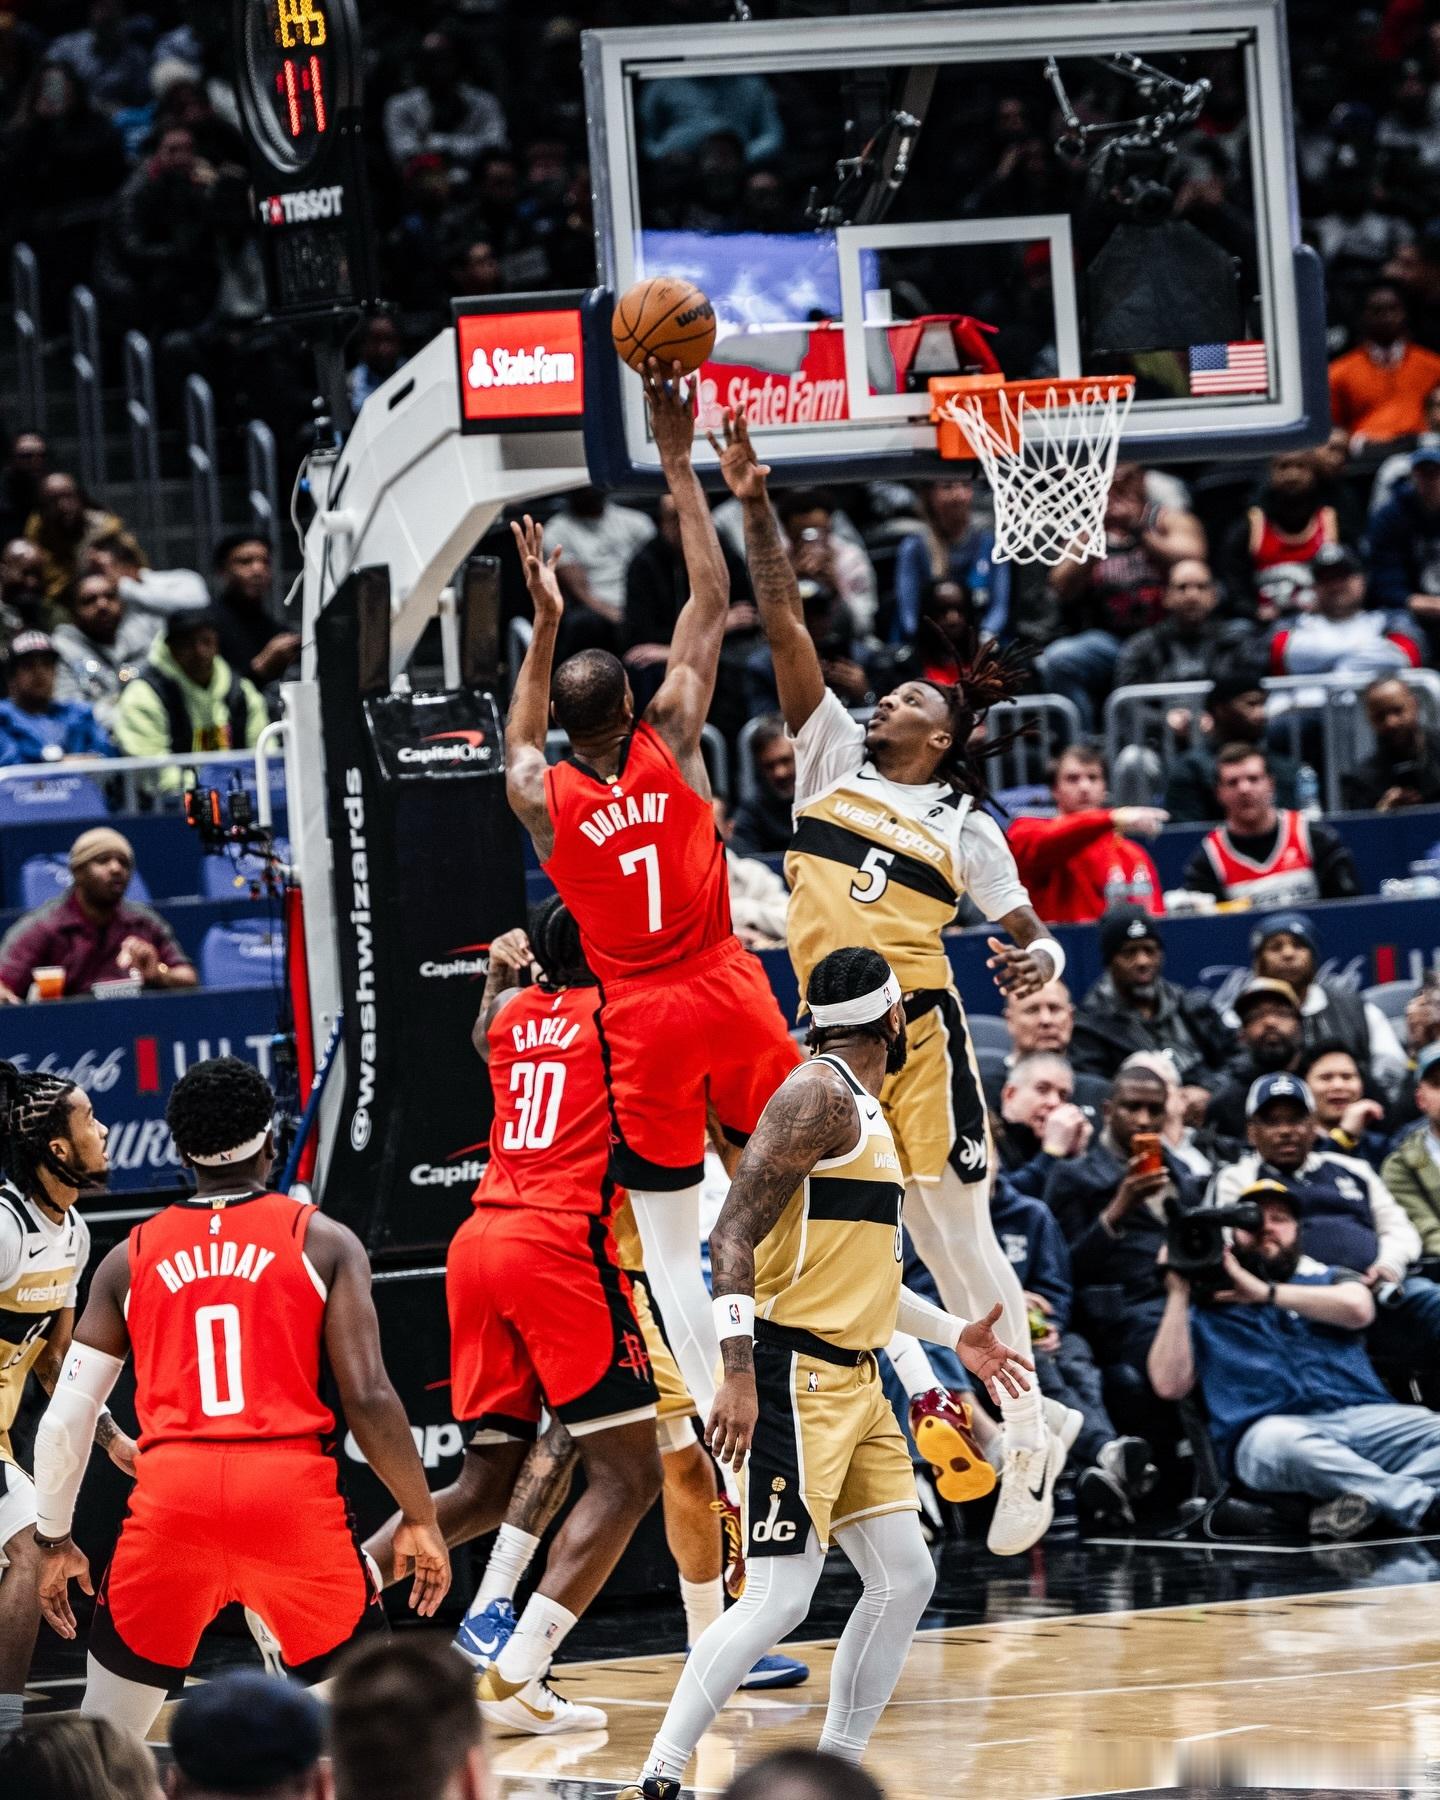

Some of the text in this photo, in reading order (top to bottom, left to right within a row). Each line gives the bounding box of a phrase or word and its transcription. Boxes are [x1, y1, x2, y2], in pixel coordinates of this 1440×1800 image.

[281, 185, 343, 223] TISSOT
[579, 792, 669, 847] DURANT
[618, 843, 663, 933] 7
[849, 847, 895, 903] 5
[344, 766, 377, 1152] @washwizards
[511, 1016, 581, 1052] CAPELA
[502, 1061, 567, 1150] 30
[156, 1241, 276, 1294] HOLIDAY
[195, 1303, 245, 1417] 0
